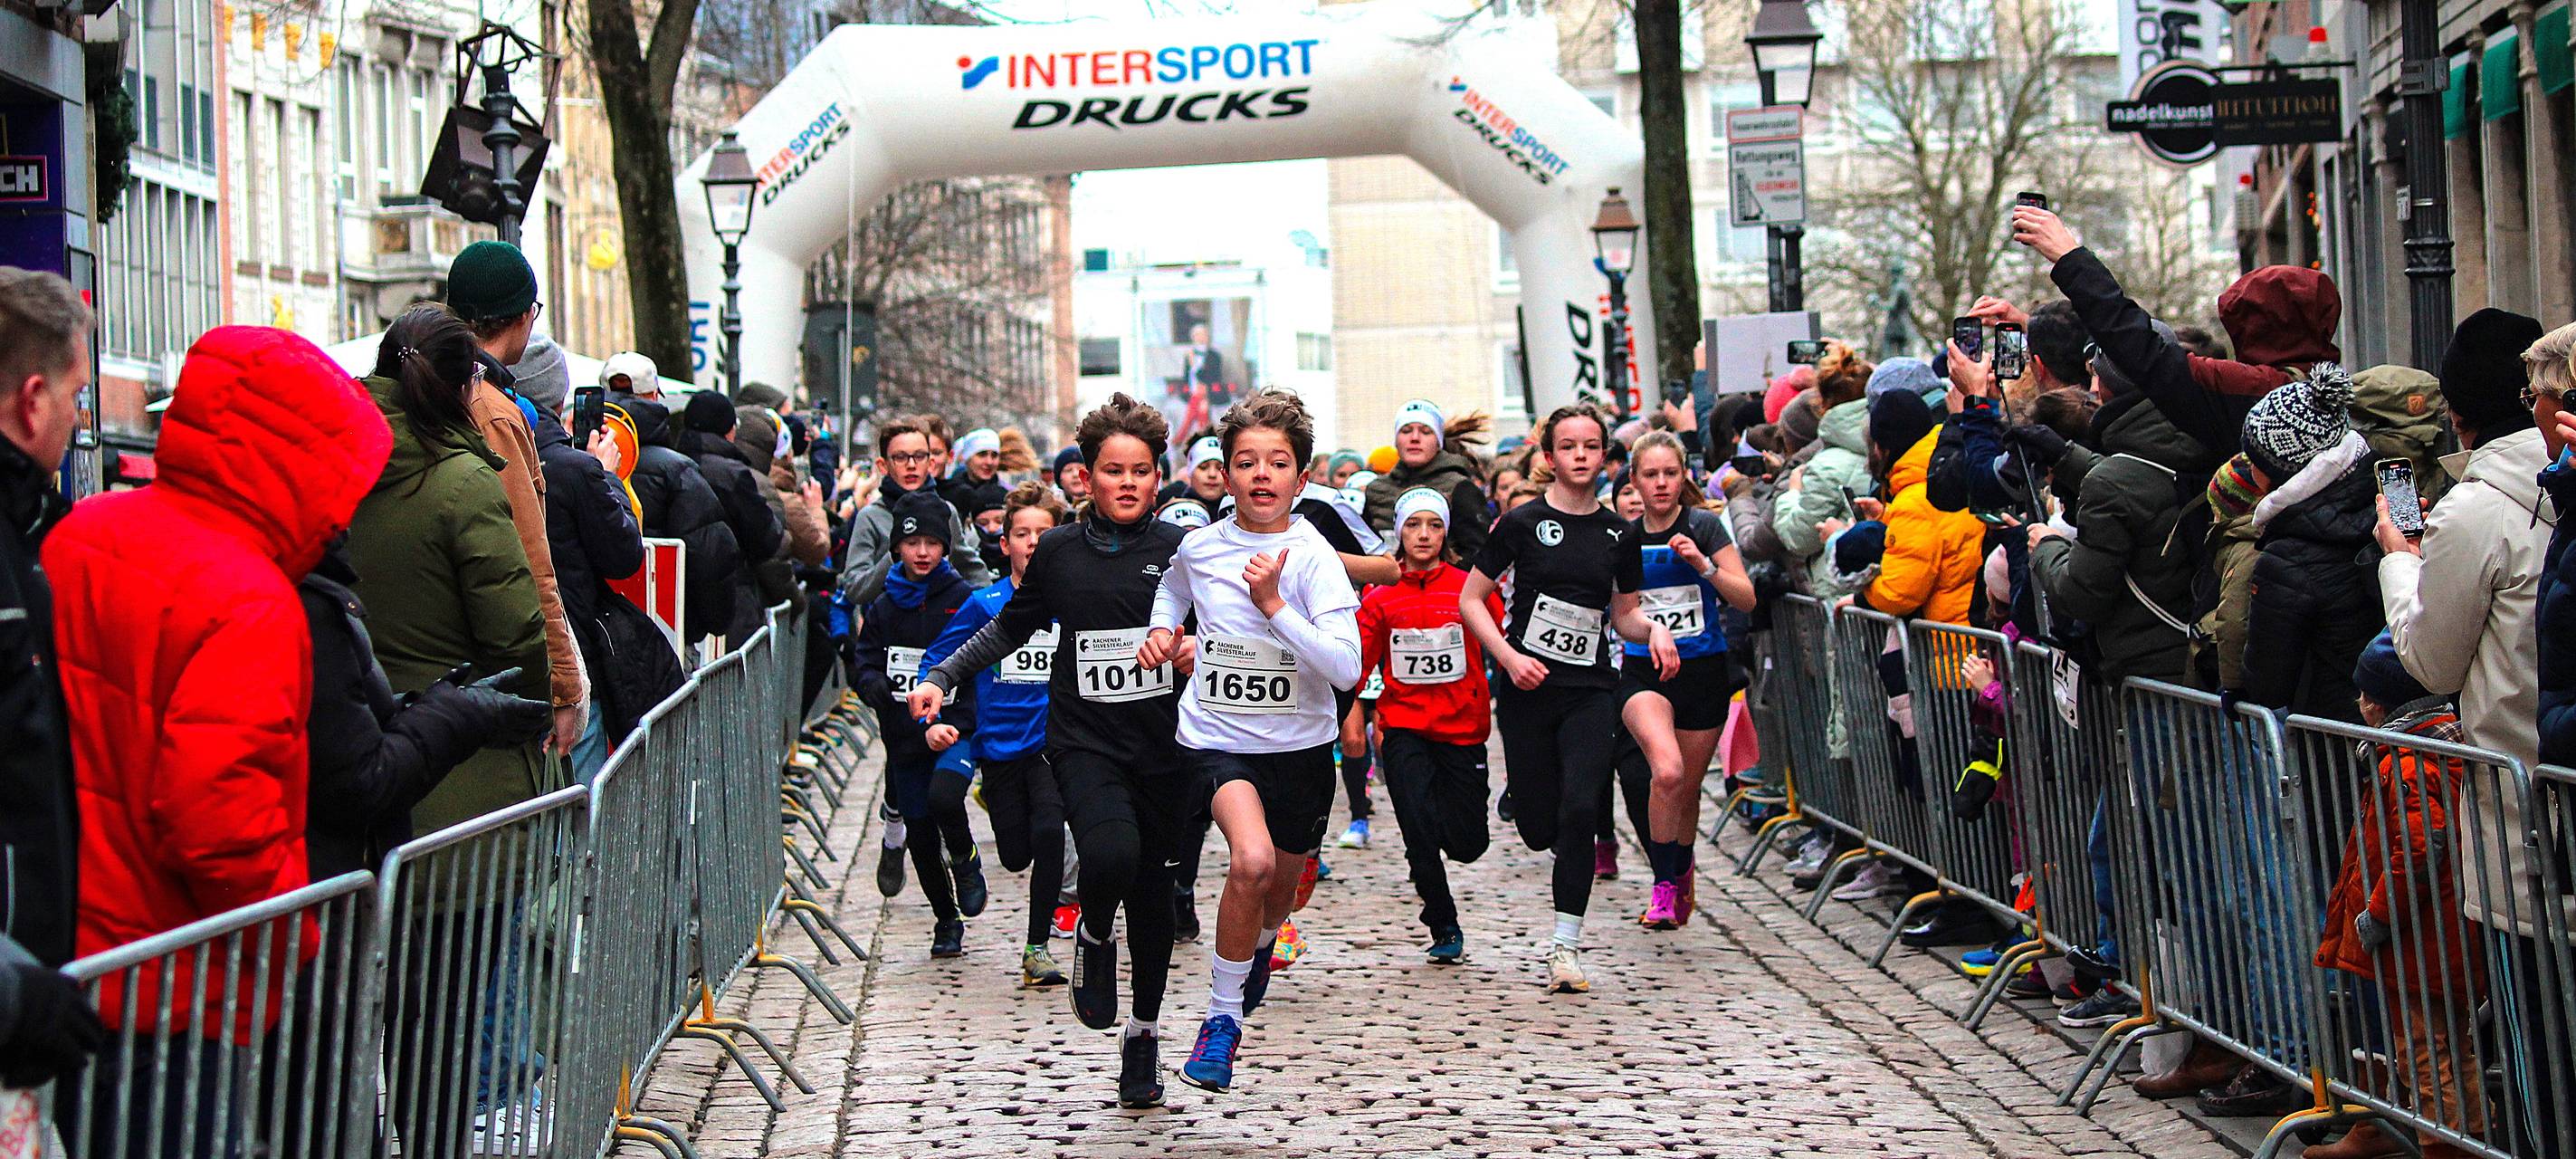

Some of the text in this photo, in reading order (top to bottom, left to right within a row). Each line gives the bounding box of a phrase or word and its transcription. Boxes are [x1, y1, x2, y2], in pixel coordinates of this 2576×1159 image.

[1008, 39, 1319, 88] INTERSPORT
[1012, 87, 1310, 129] DRUCKS
[2112, 102, 2214, 122] nadelkunst
[1463, 89, 1570, 175] INTERSPORT
[1452, 109, 1553, 187] DRUCKS
[762, 119, 850, 206] DRUCKS
[0, 165, 38, 192] CH
[1647, 608, 1696, 631] 021
[1092, 641, 1134, 649] SILVESTERLAUF
[1216, 641, 1245, 651] AACHENER
[1216, 647, 1256, 657] SILVESTERLAUF
[1539, 628, 1589, 656] 438
[1085, 663, 1163, 692] 1011
[1404, 654, 1454, 675] 738
[1205, 670, 1291, 703] 1650
